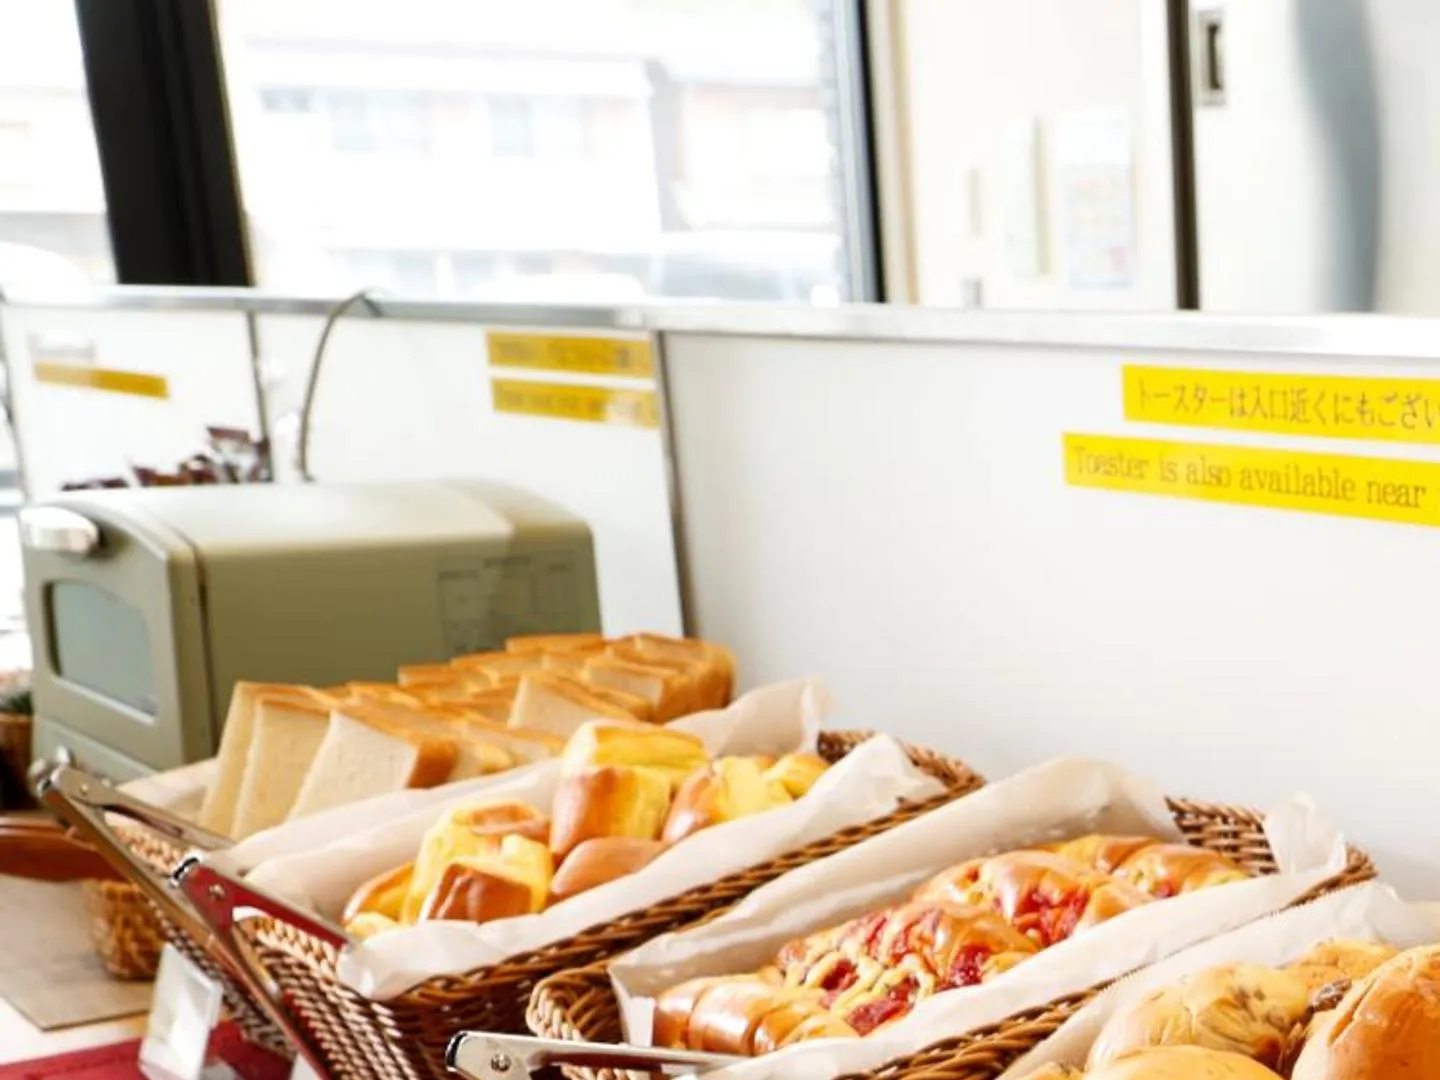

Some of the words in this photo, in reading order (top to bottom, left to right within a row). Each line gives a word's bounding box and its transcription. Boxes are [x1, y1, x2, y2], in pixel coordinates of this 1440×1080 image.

[1159, 454, 1179, 484] is
[1186, 455, 1232, 488] also
[1239, 461, 1356, 502] available
[1366, 478, 1426, 509] near
